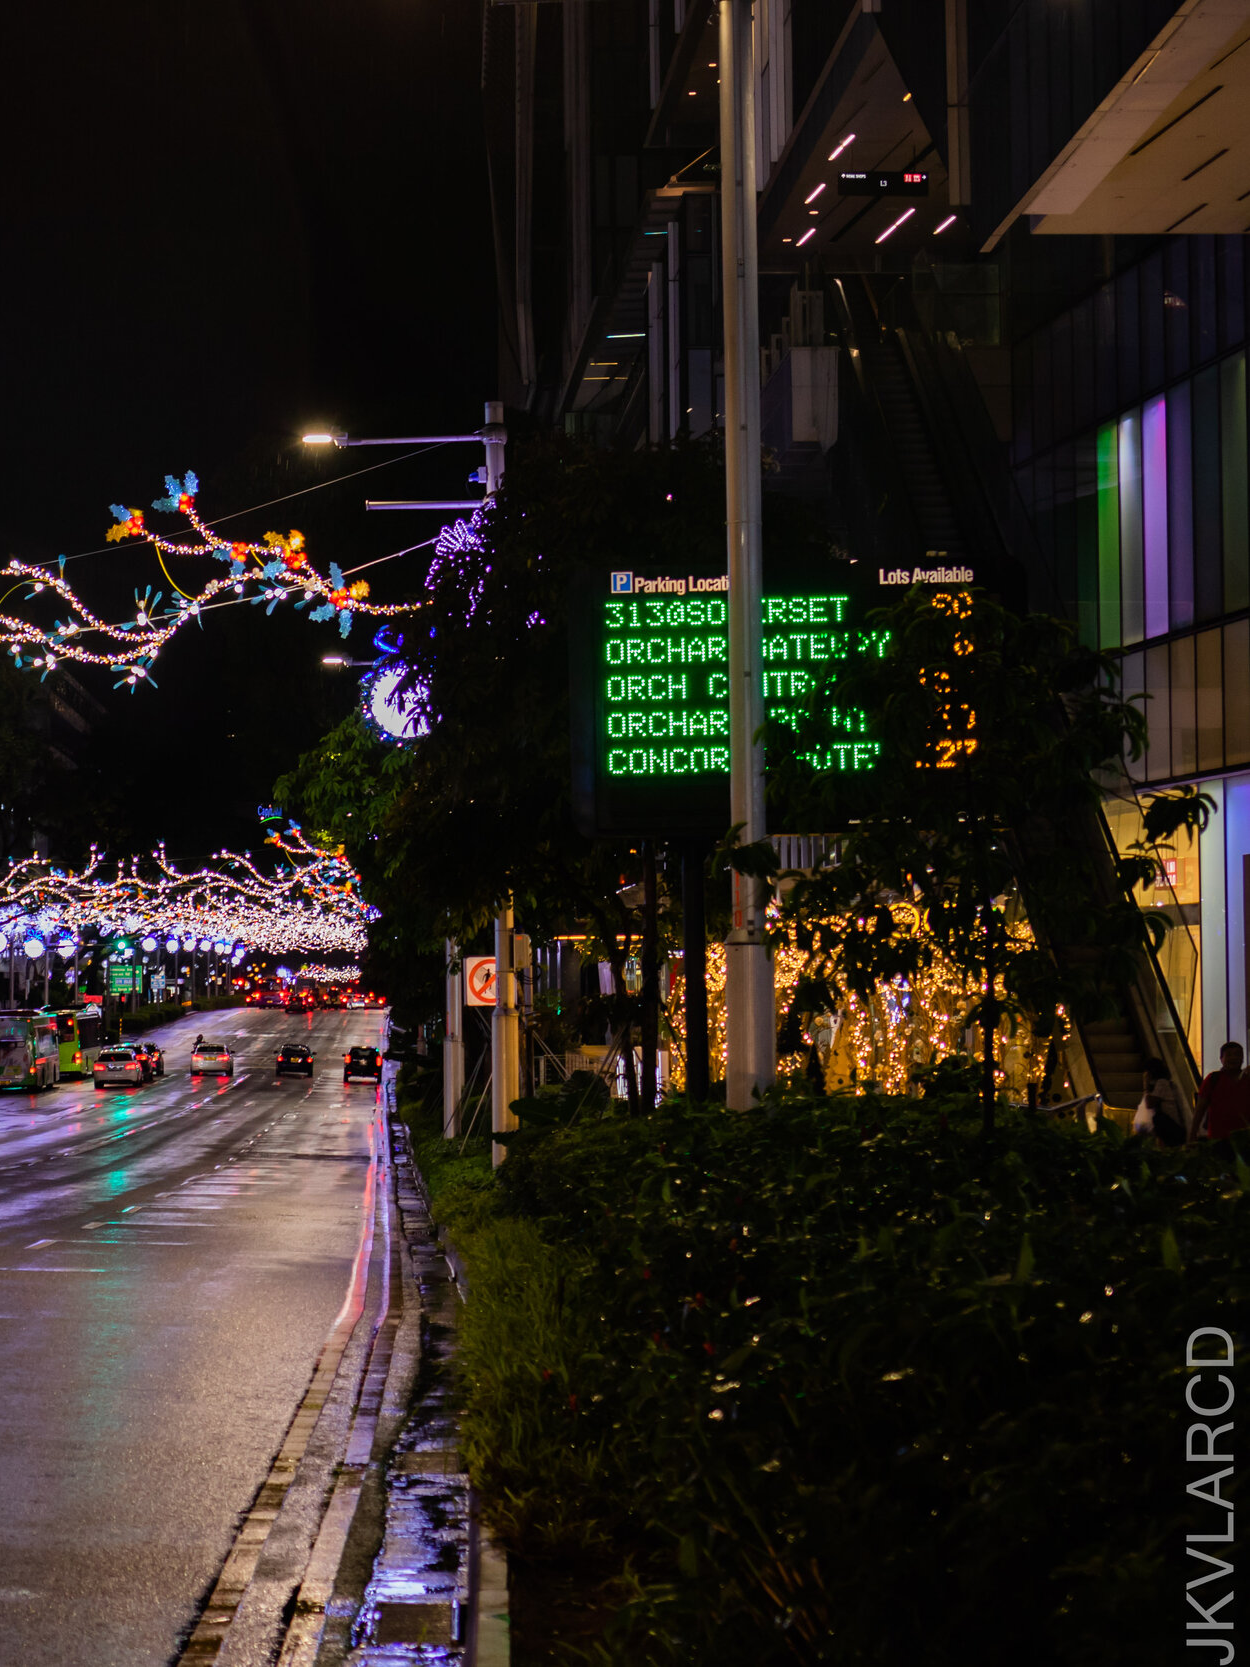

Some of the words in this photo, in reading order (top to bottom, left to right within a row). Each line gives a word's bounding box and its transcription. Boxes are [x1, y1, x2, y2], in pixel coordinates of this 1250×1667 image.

[634, 576, 686, 596] Parking
[688, 575, 729, 592] Locati
[879, 568, 910, 585] Lots
[912, 566, 974, 583] Available
[607, 674, 687, 701] ORCH
[607, 709, 729, 738] ORCHAR
[607, 743, 730, 775] CONCOR
